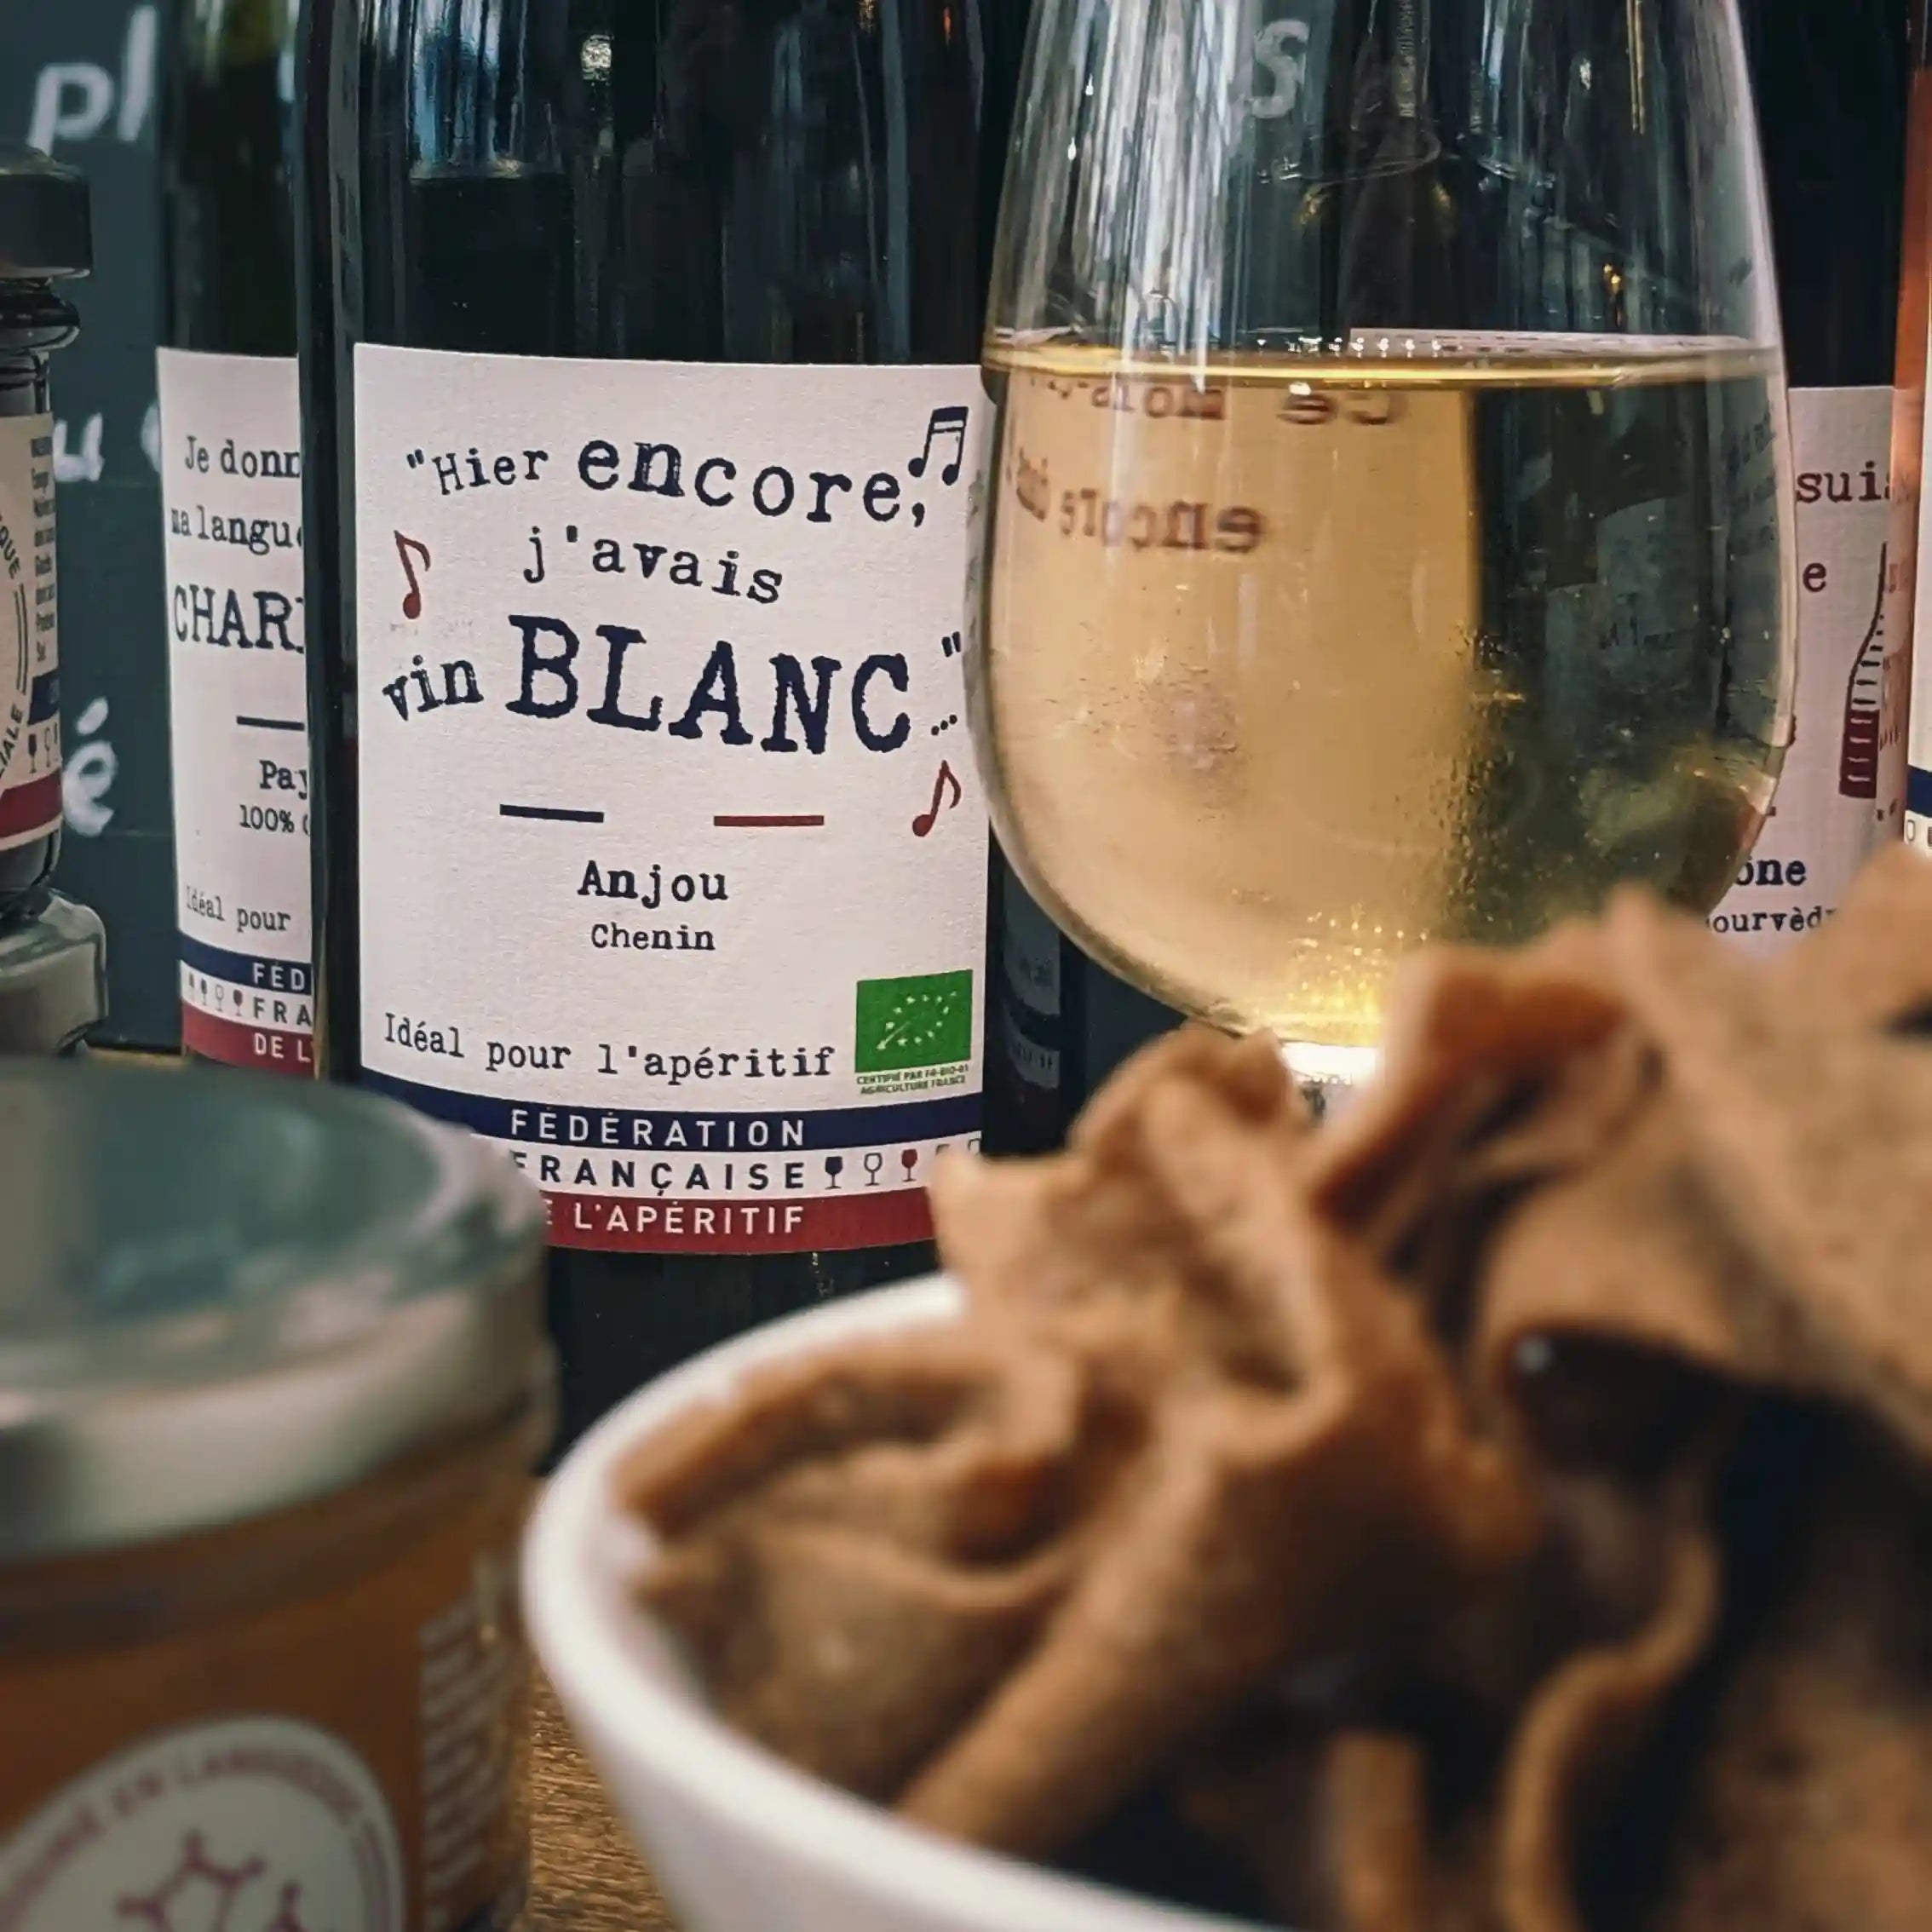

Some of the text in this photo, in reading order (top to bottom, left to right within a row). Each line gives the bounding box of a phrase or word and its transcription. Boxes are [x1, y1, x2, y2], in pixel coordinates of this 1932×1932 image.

[185, 435, 210, 474] Je
[578, 439, 927, 528] encore,
[1796, 460, 1890, 503] sui
[523, 526, 783, 604] j'avais
[174, 584, 304, 654] CHAR
[382, 655, 483, 722] vin
[239, 804, 295, 833] 100%
[578, 860, 729, 910] Anjou
[187, 885, 291, 933] Idéal pour
[1706, 906, 1837, 934] ourvèd
[591, 923, 716, 952] Chenin
[253, 996, 312, 1026] FRA
[254, 1032, 285, 1059] DE
[383, 1012, 836, 1087] Idéal pour l'apéritif
[511, 1106, 804, 1147] FÉDÉRATION
[573, 1200, 804, 1235] L'APÉRITIF
